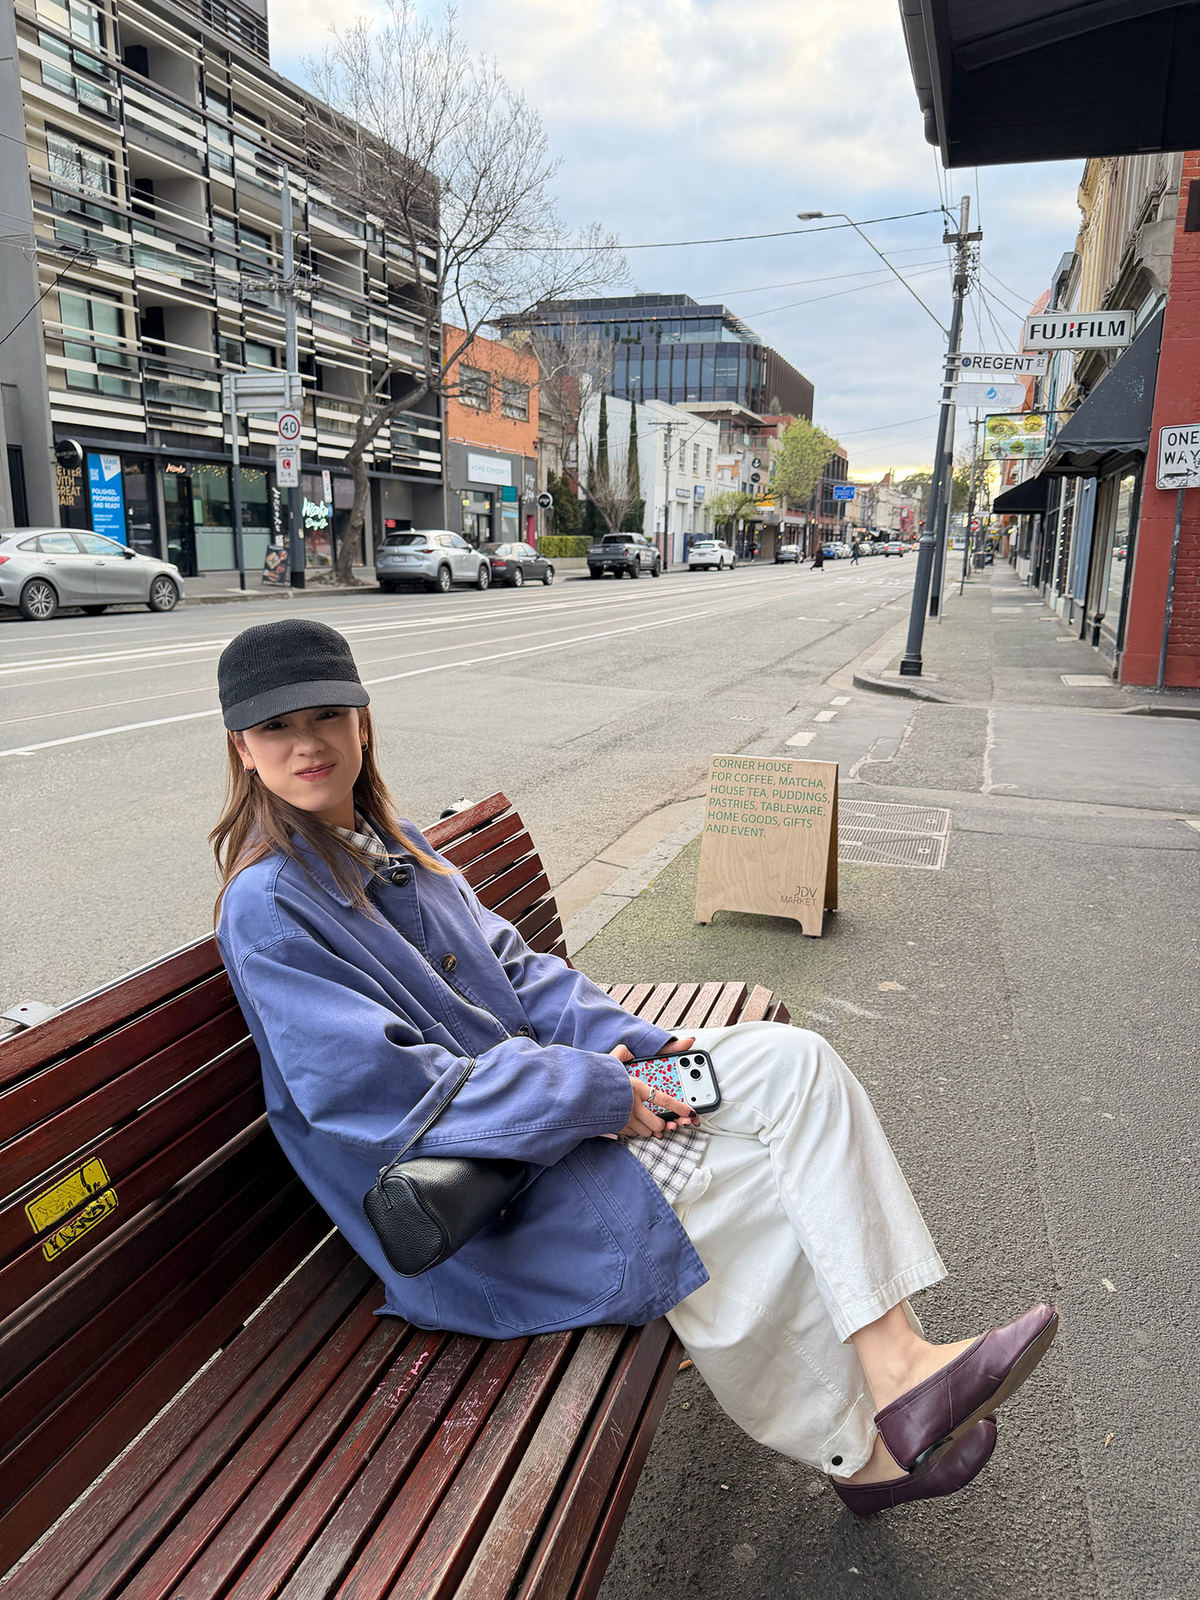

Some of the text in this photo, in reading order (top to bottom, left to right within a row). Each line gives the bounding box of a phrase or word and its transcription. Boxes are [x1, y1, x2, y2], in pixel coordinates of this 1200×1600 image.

[1030, 320, 1125, 340] FUJIFILM
[972, 356, 1046, 370] REGENT ST
[282, 422, 297, 433] 40
[1168, 431, 1199, 446] ONE
[1164, 450, 1200, 465] WAY
[472, 464, 485, 472] HOME
[104, 502, 120, 510] READY
[712, 758, 793, 772] CORNER HOUSE
[711, 772, 826, 789] FOR COFFEE, MATCHA,
[710, 785, 830, 804] HOUSE TEA, PUDDINGS,
[709, 798, 826, 817] PASTRIES, TABLEWARE,
[707, 811, 812, 828] HOME GOODS, GIFTS
[706, 824, 766, 837] AND EVENT.
[795, 886, 817, 898] JDV
[781, 895, 817, 906] MARKET
